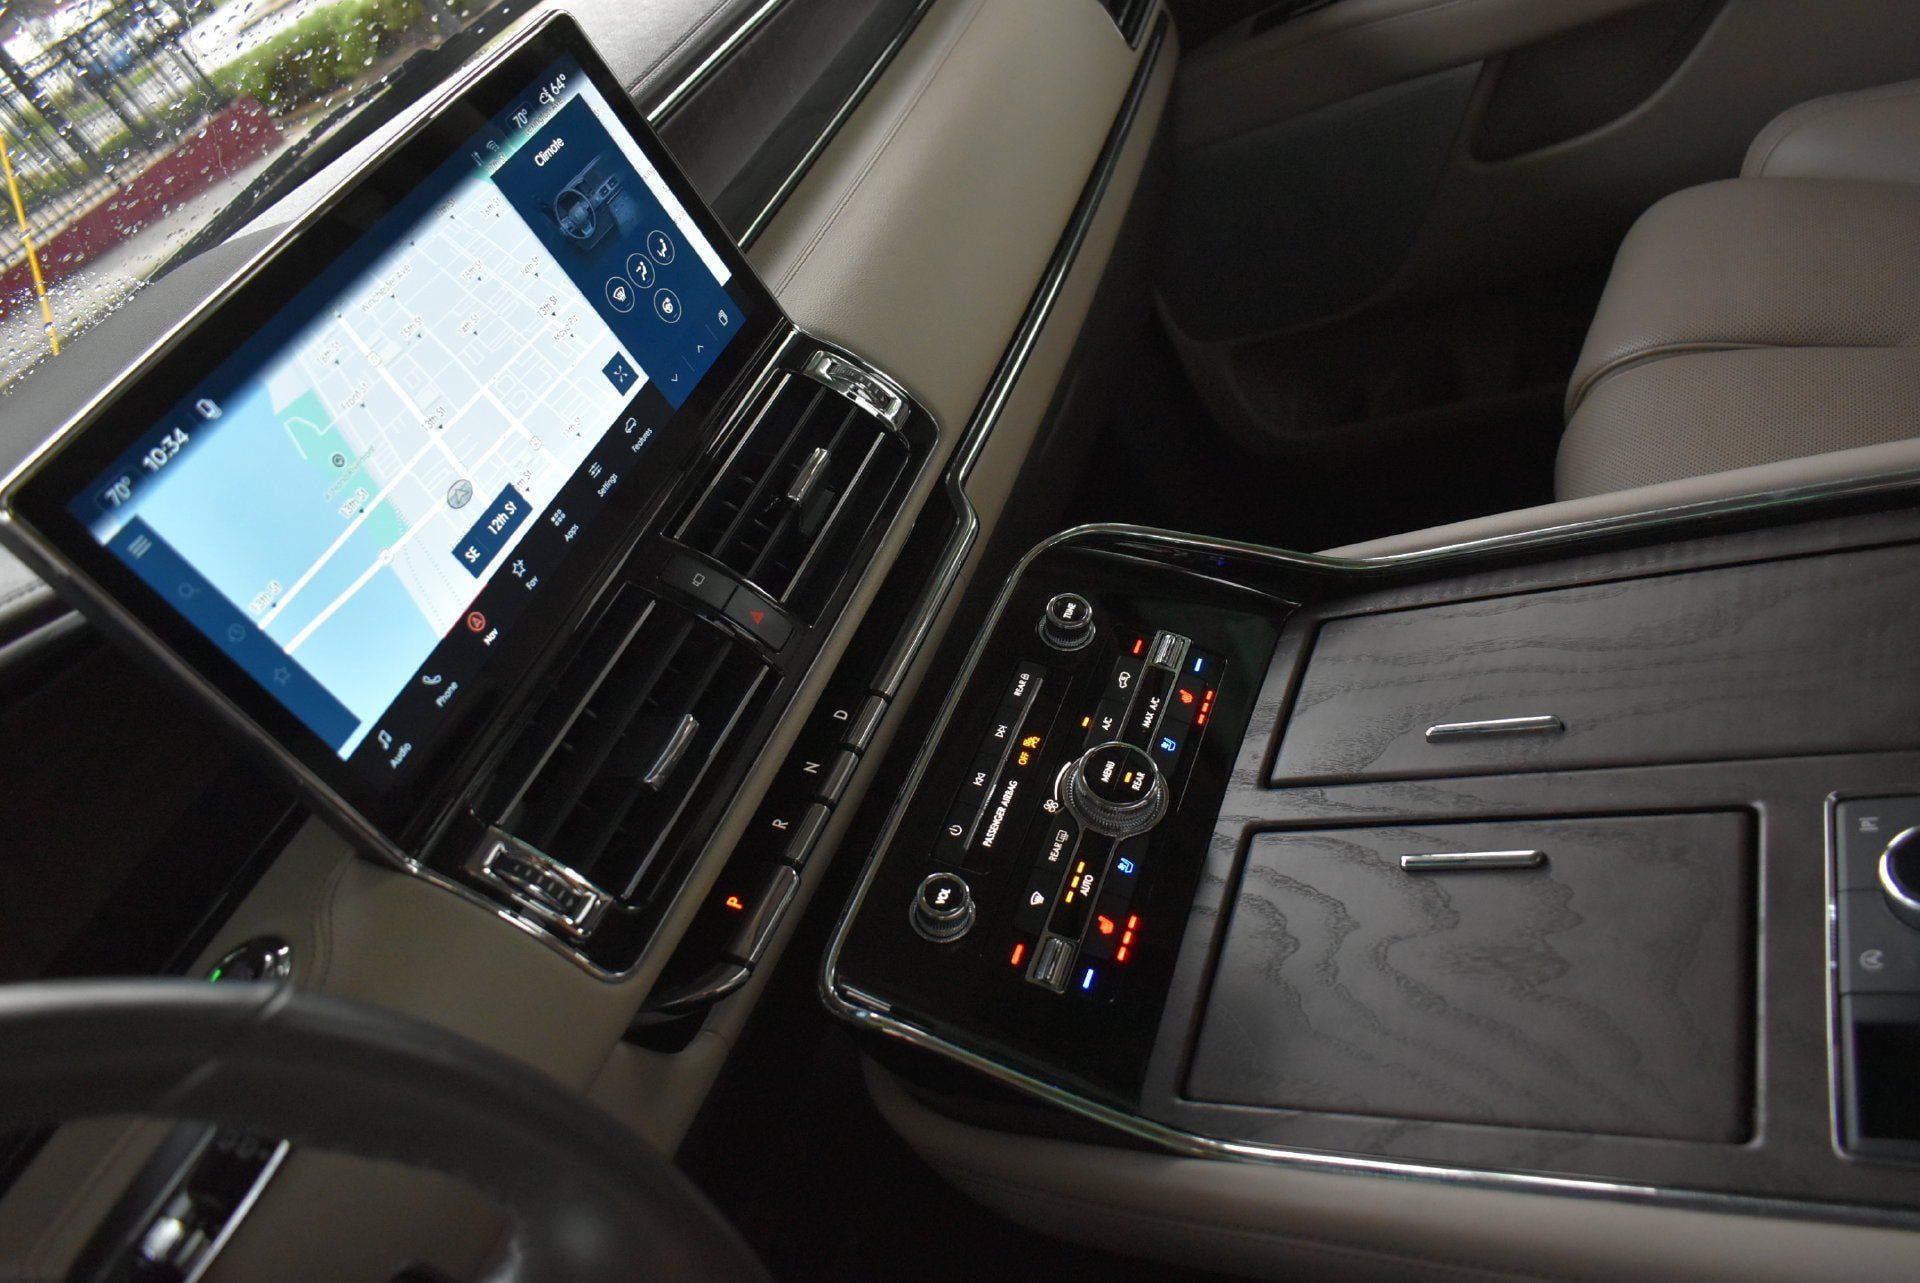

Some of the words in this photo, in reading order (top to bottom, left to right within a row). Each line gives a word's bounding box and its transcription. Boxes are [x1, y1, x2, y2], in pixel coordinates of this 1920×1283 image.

[550, 73, 566, 95] 64°
[512, 108, 528, 128] 70°
[534, 137, 565, 167] Climate
[537, 303, 550, 318] 13th
[550, 295, 558, 306] St
[422, 415, 436, 431] 13th
[436, 406, 446, 418] St
[142, 427, 189, 471] 10:34
[631, 427, 653, 453] Features
[105, 475, 131, 505] 70°
[597, 473, 618, 497] Settings
[342, 499, 358, 517] 13th
[357, 489, 368, 501] St
[487, 511, 510, 535] 12th
[504, 500, 517, 515] St
[564, 523, 579, 542] Apps
[464, 545, 481, 563] SE
[268, 581, 281, 594] St
[525, 576, 538, 591] Fav
[1063, 602, 1077, 619] TUNE
[483, 627, 498, 646] Nav
[435, 681, 459, 708] Phone
[1014, 681, 1027, 697] REAR
[833, 709, 849, 721] D
[1101, 716, 1113, 731] A/C
[1142, 711, 1154, 729] MAX
[1150, 697, 1160, 711] A/C
[390, 742, 412, 770] Audio
[803, 761, 821, 774] N
[1101, 761, 1115, 783] MENU
[1131, 771, 1146, 792] REAR
[983, 807, 1007, 848] PASSENGER
[1000, 780, 1018, 808] AIRBAG
[1018, 751, 1030, 766] OFF
[771, 817, 789, 830] R
[1048, 843, 1063, 862] REAR
[935, 888, 952, 904] VOL
[1080, 874, 1094, 897] AUTO
[726, 896, 743, 910] P
